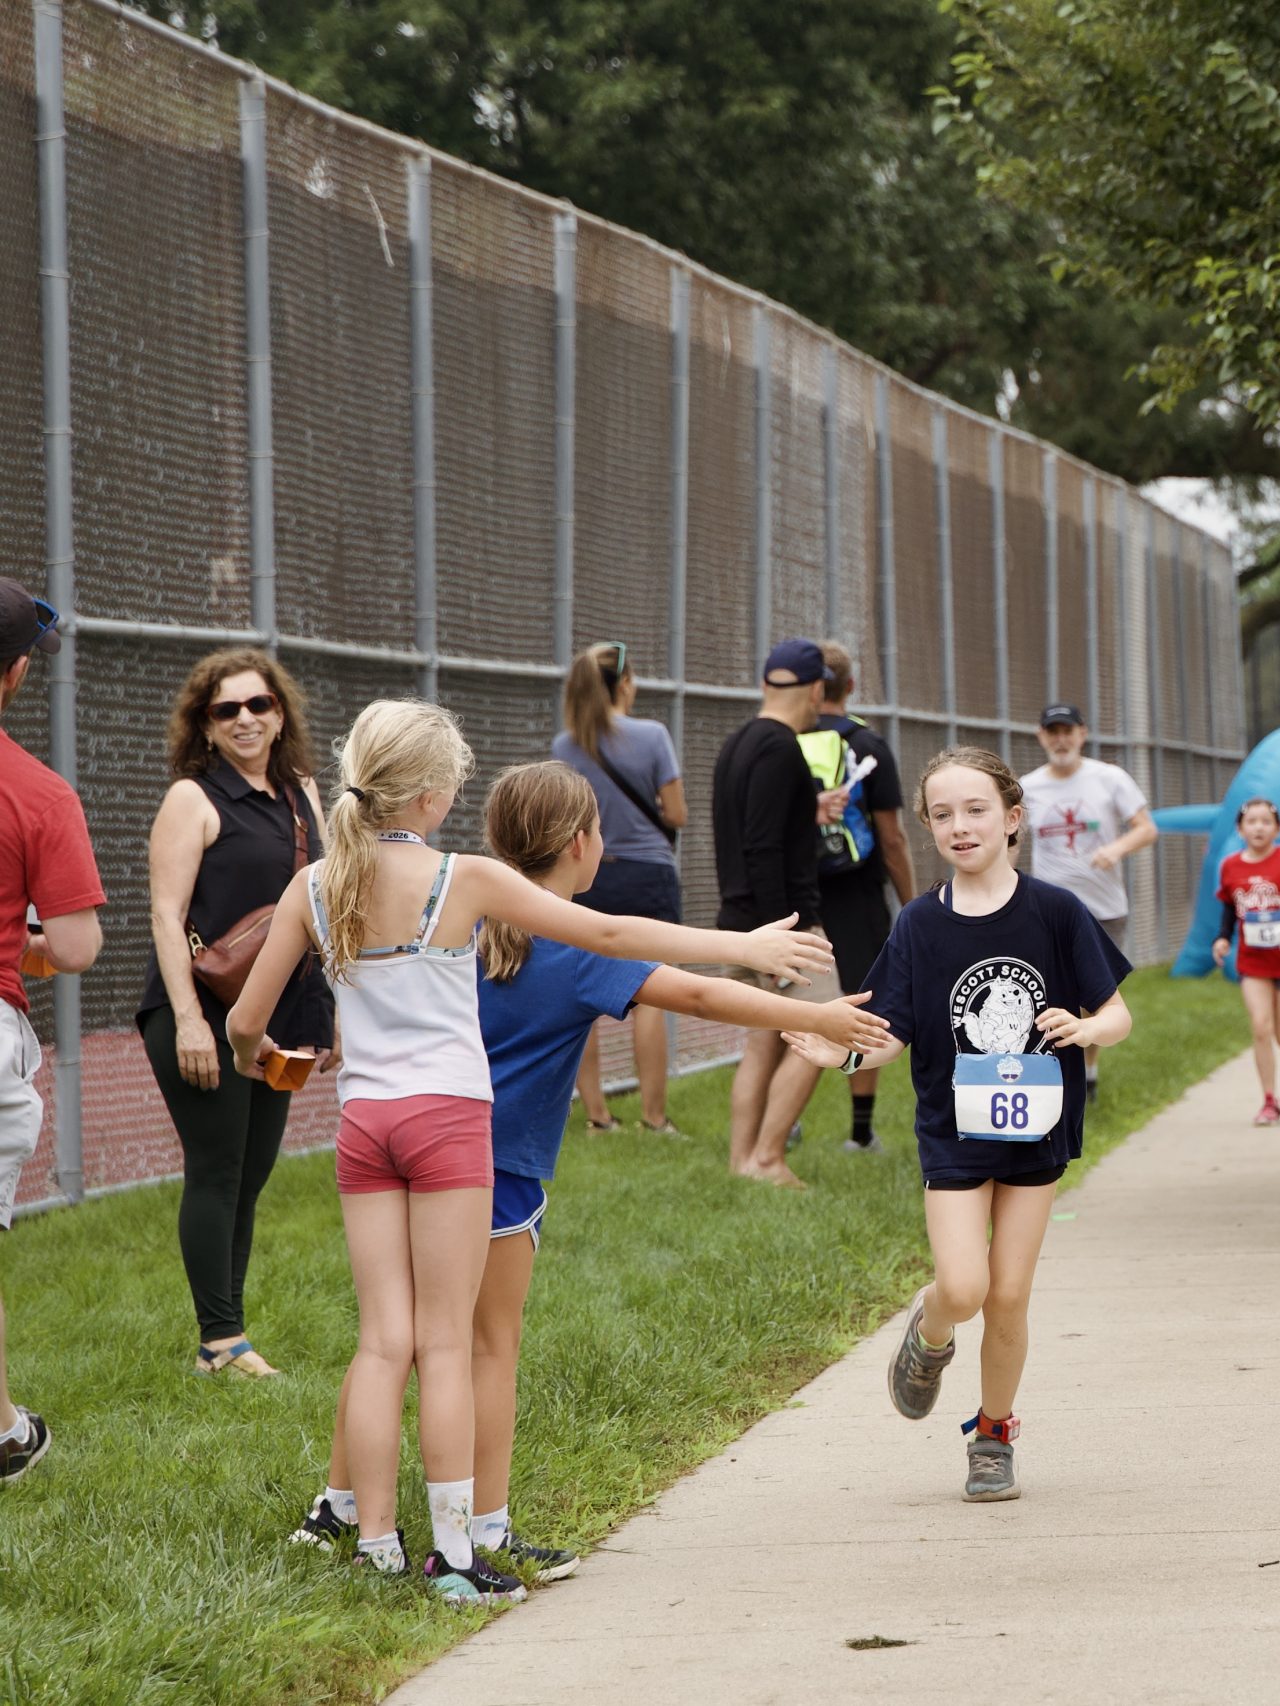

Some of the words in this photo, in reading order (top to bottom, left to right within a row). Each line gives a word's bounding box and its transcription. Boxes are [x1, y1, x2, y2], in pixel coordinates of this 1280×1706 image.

[953, 966, 994, 1028] WESCOTT
[1001, 965, 1046, 1010] SCHOOL
[990, 1092, 1029, 1130] 68
